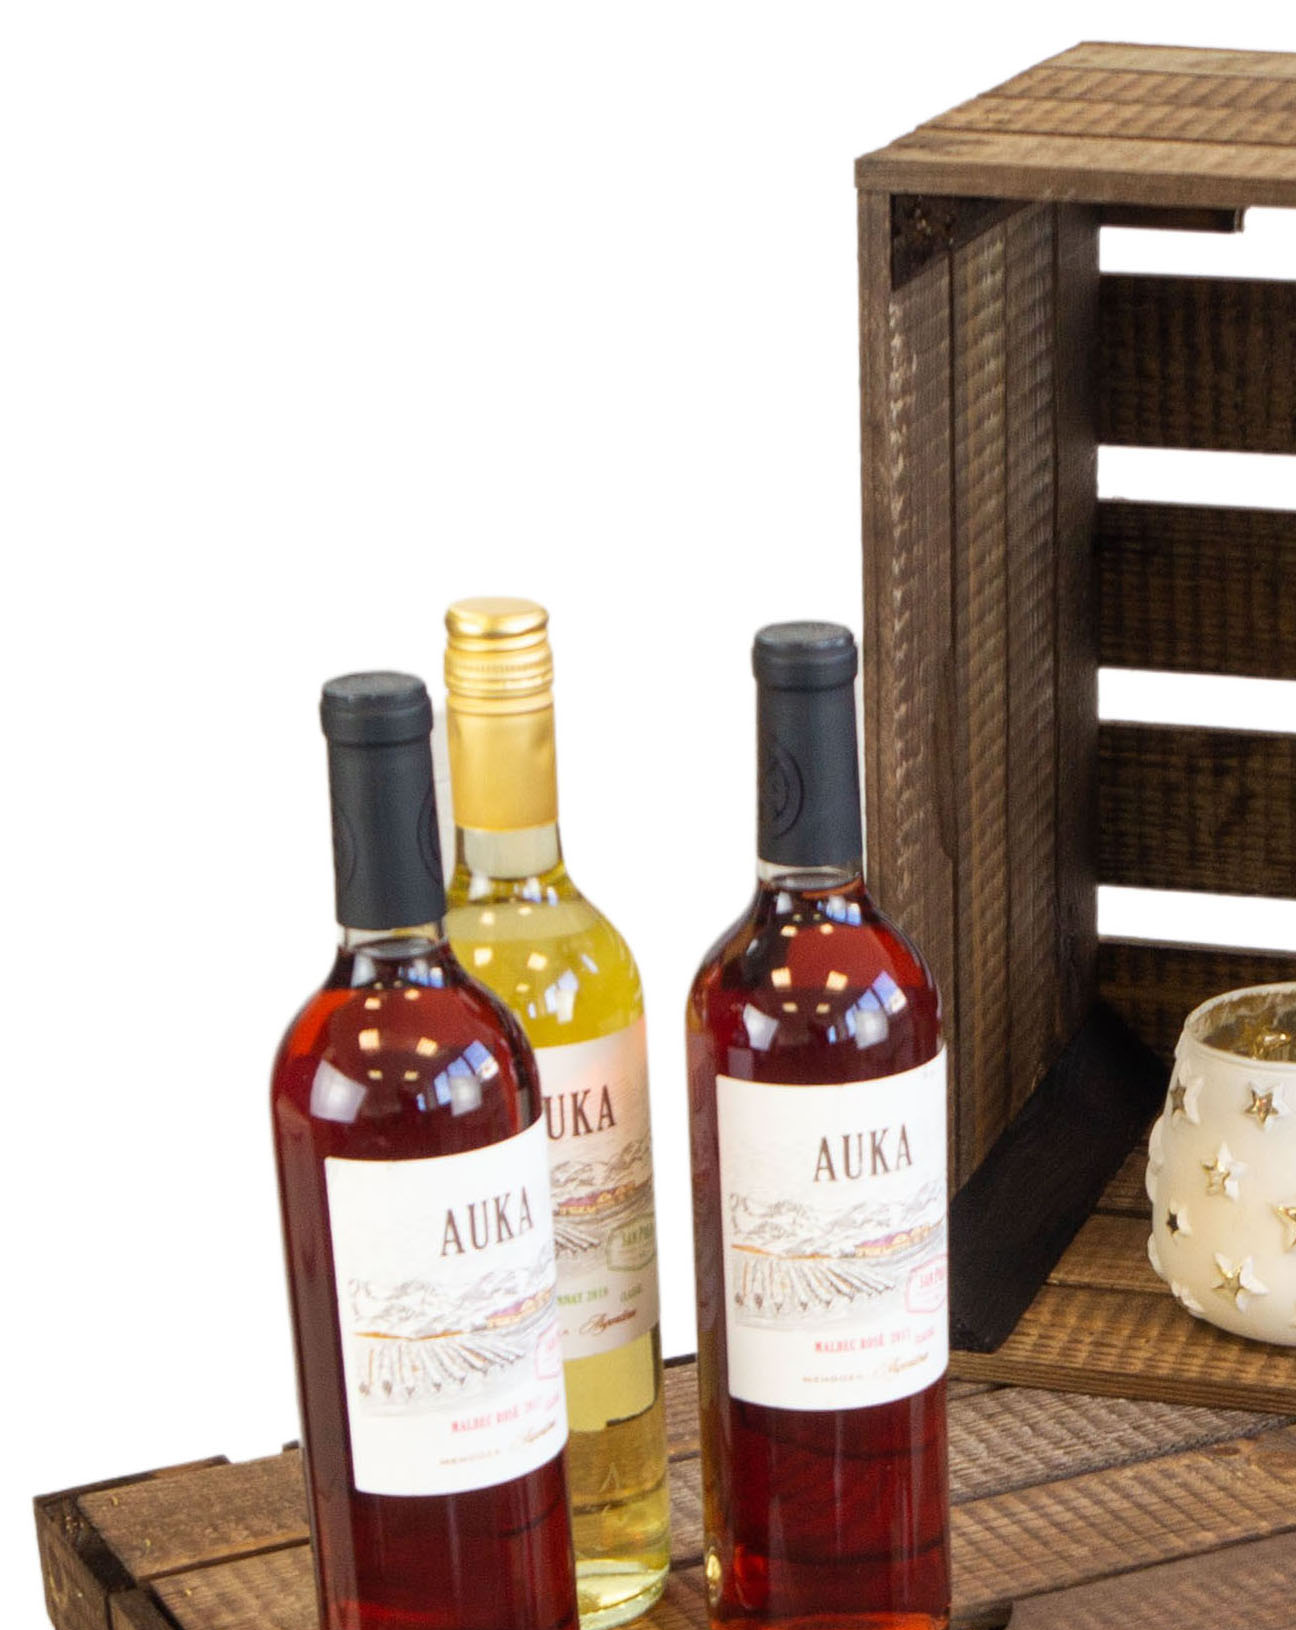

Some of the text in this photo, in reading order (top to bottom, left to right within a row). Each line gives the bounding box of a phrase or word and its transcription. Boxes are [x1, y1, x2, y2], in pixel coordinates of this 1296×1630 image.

[541, 1083, 617, 1141] UKA
[813, 1123, 914, 1184] AUKA
[439, 1186, 535, 1257] AUKA
[814, 1338, 856, 1353] MALBEC
